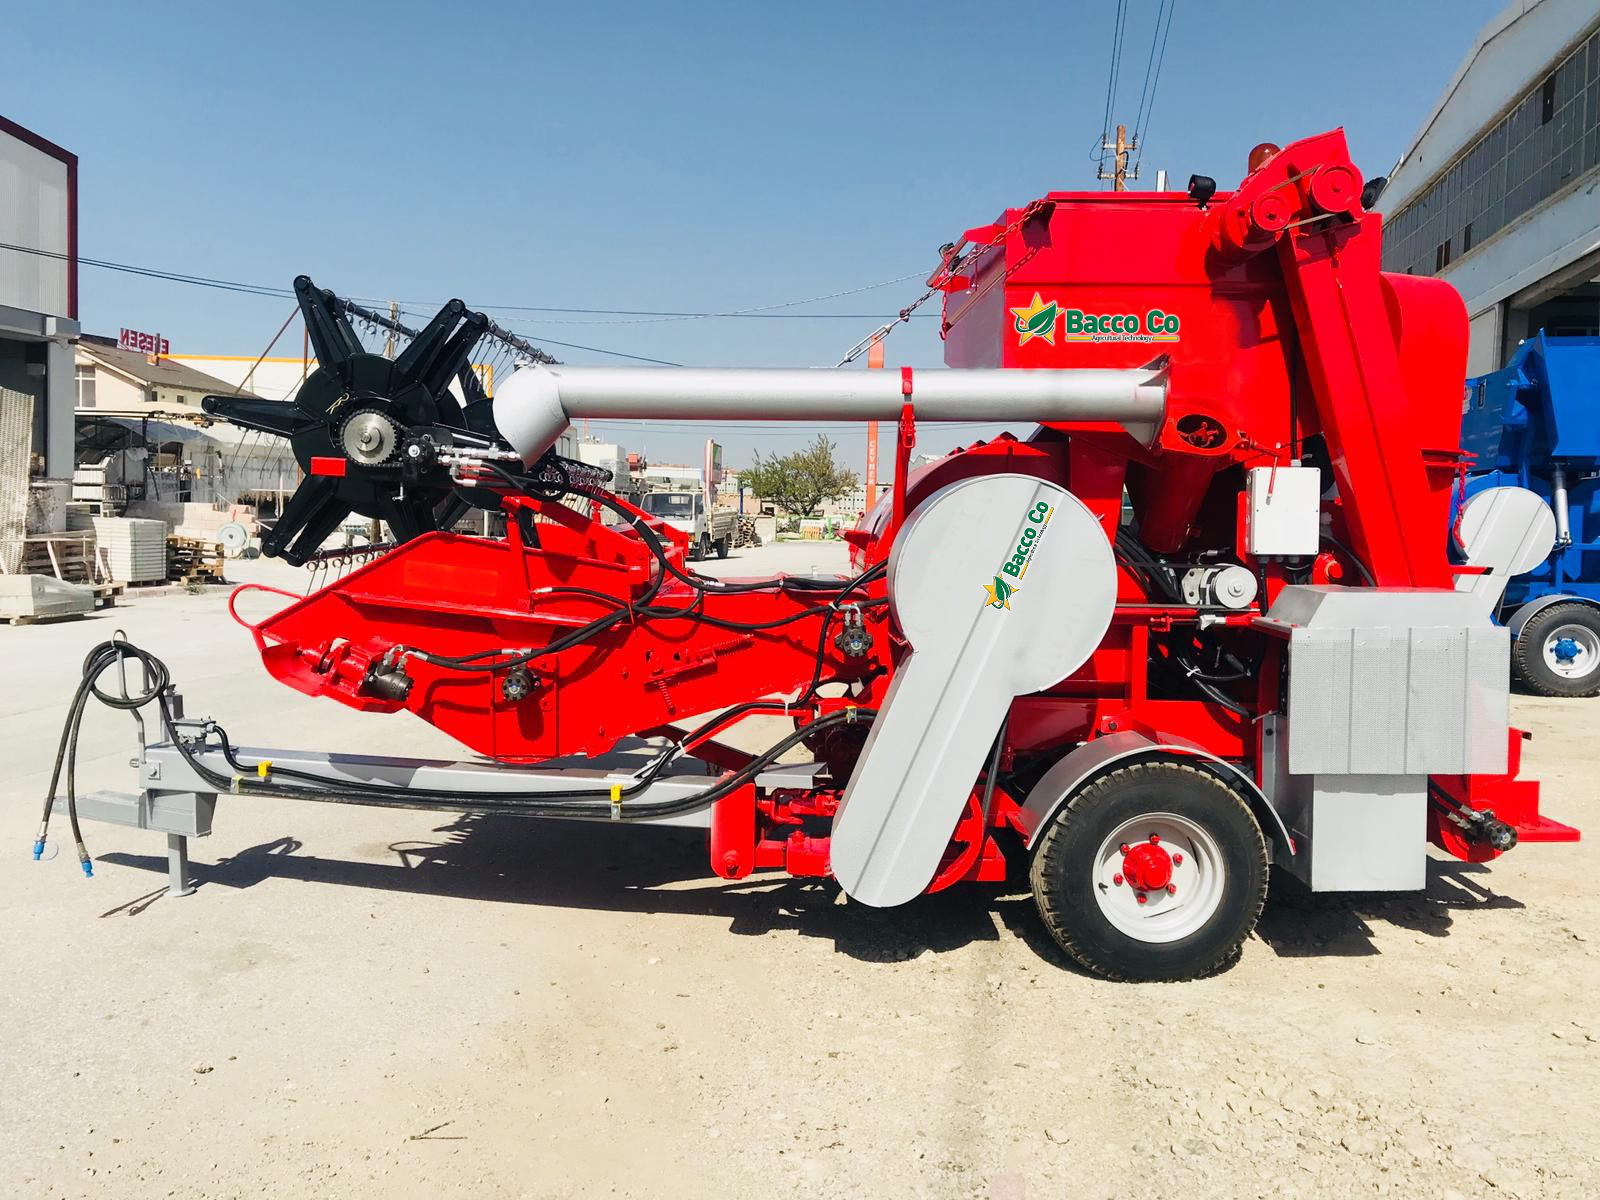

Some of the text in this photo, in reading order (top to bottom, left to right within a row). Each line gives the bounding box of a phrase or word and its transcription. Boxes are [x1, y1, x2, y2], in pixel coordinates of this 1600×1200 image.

[1066, 310, 1179, 334] Bacco Co
[1091, 335, 1153, 343] Agricultural Technology
[1002, 527, 1037, 578] Bacco
[1027, 501, 1049, 524] Co
